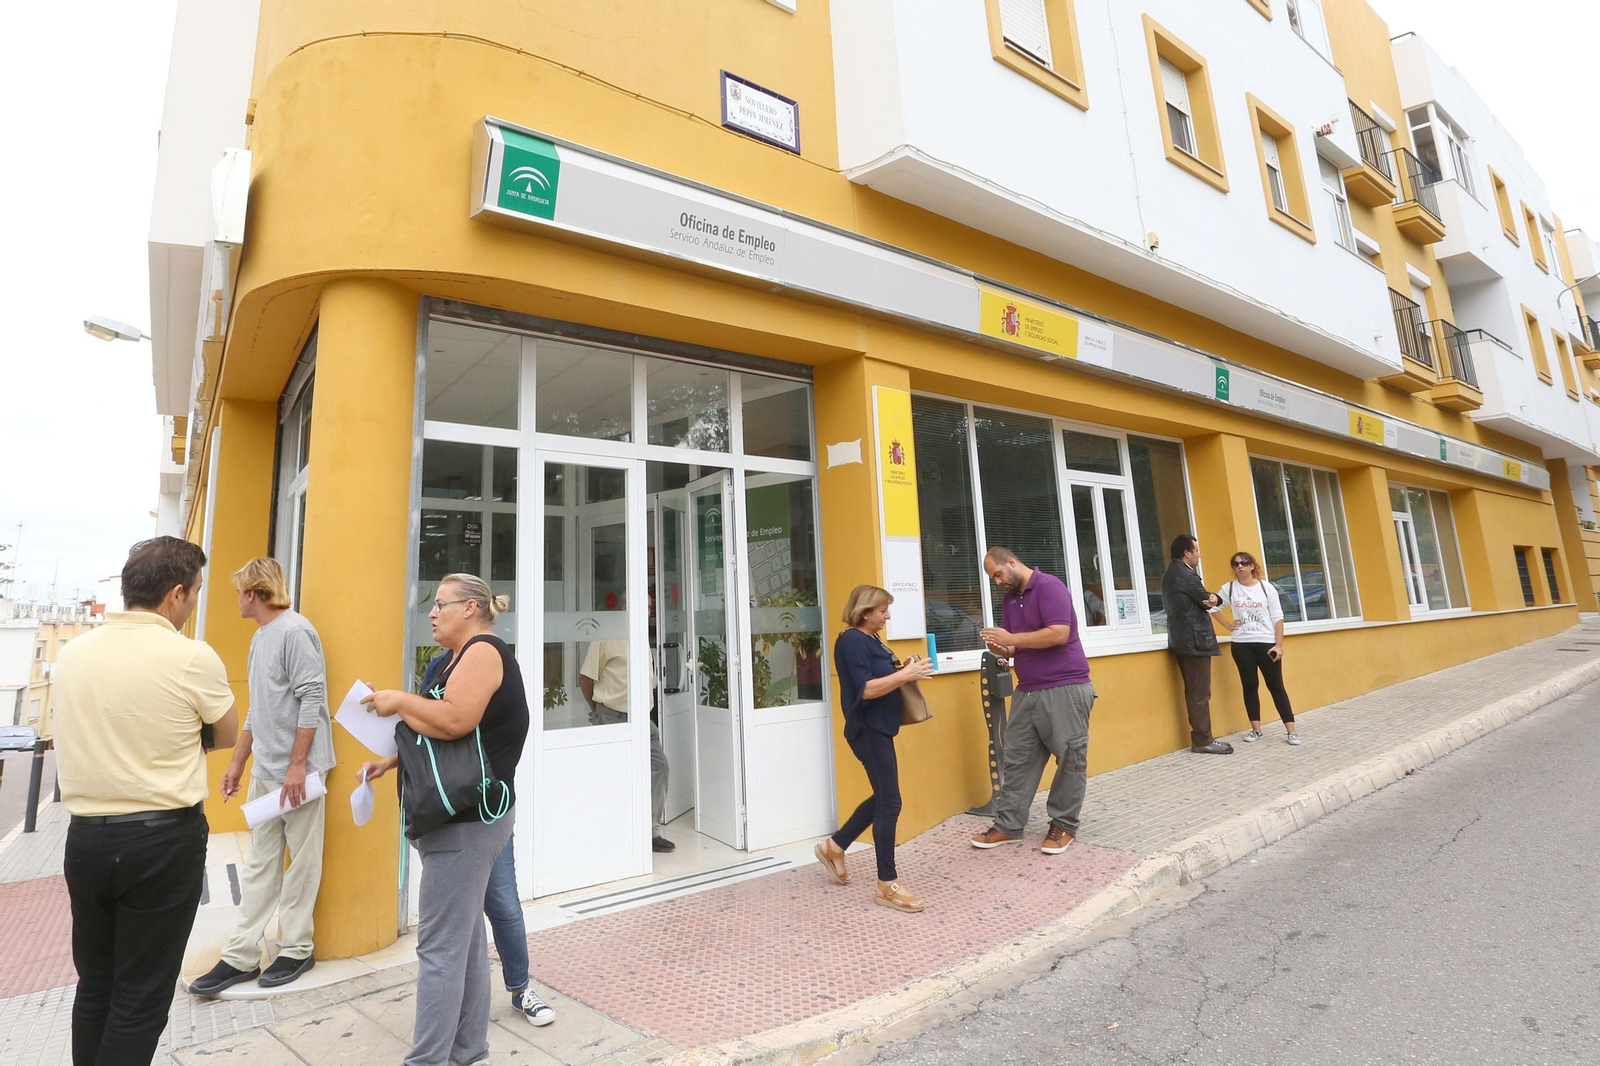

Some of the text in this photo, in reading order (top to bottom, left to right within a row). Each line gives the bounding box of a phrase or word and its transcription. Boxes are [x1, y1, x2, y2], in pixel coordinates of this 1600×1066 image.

[745, 96, 777, 117] NOVILLERO
[506, 189, 519, 197] JUNTA
[680, 212, 776, 252] Oficina de Empleo
[669, 228, 775, 266] Servicio Andaluz de Empleo
[759, 526, 782, 538] Empleo
[1234, 600, 1263, 608] SEASON
